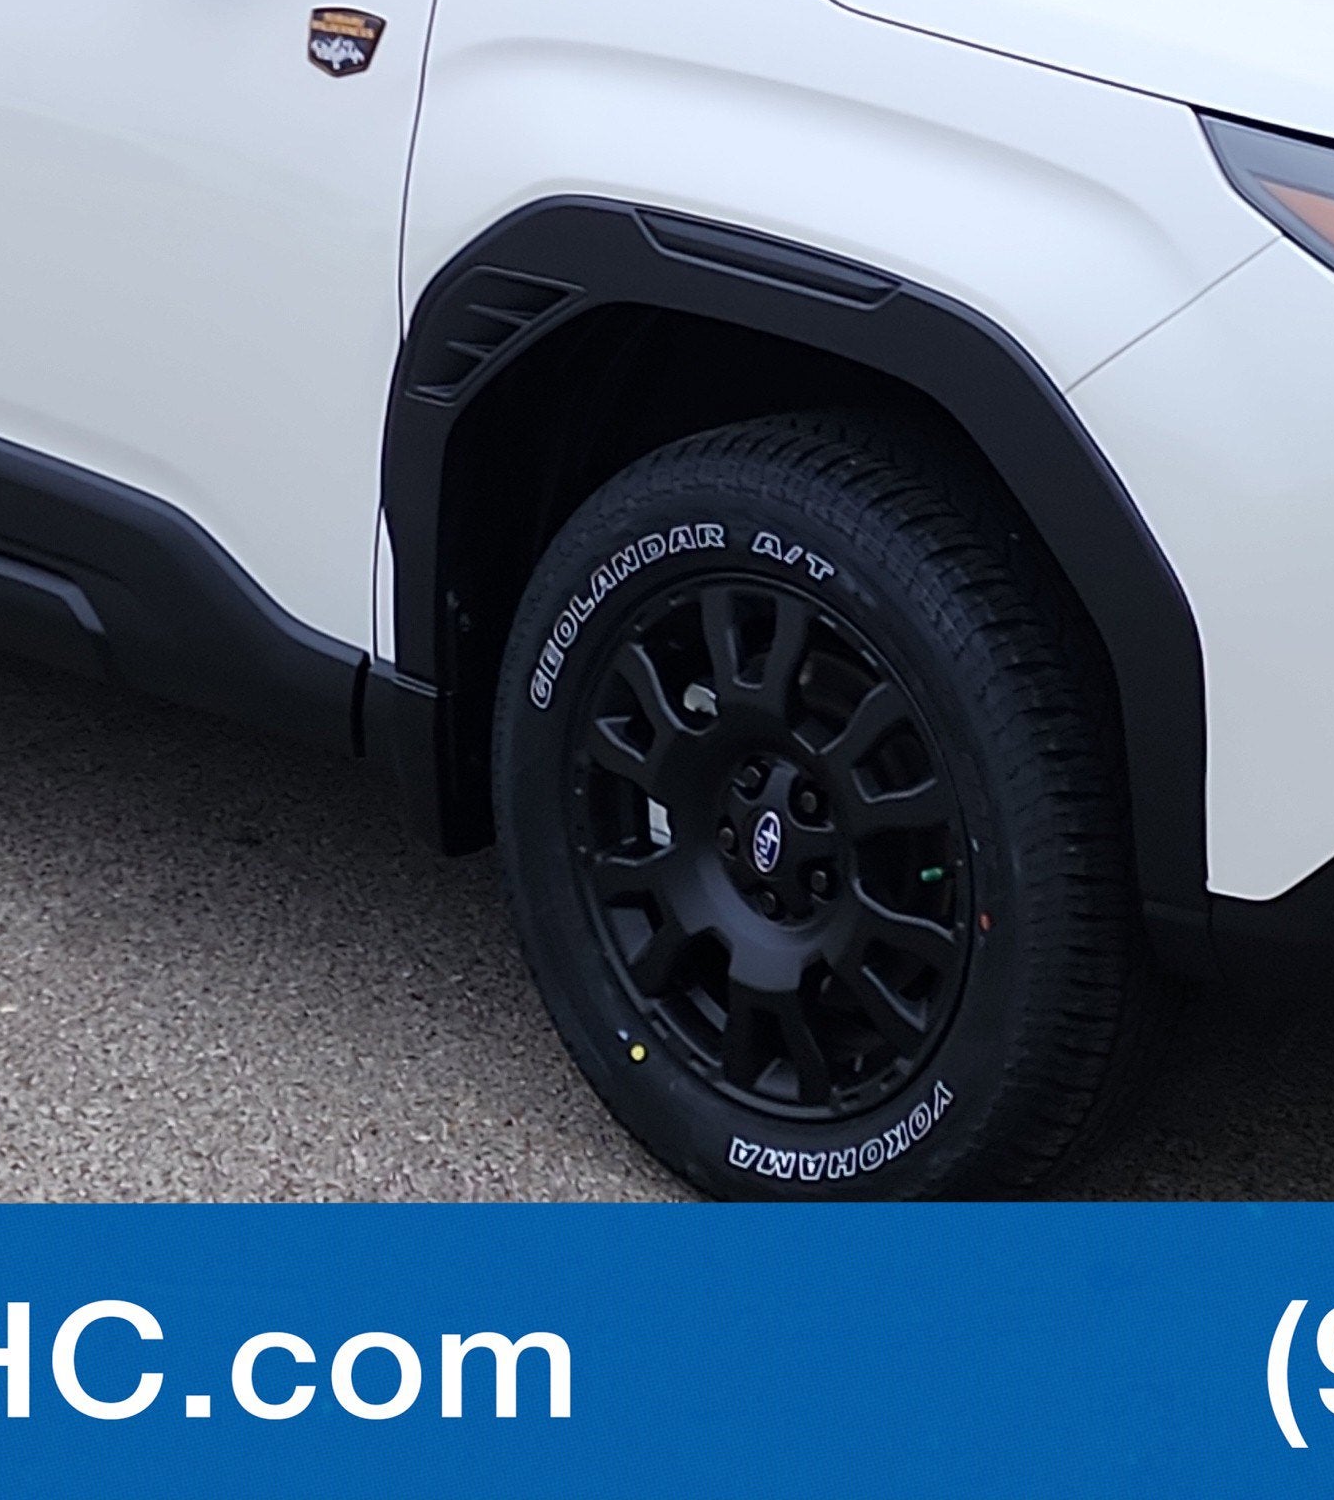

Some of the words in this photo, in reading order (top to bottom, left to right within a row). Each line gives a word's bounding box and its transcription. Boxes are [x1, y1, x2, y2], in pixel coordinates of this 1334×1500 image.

[529, 523, 726, 710] GEOLANDAR
[751, 530, 836, 581] A/T
[728, 1079, 954, 1182] YOKOHAMA
